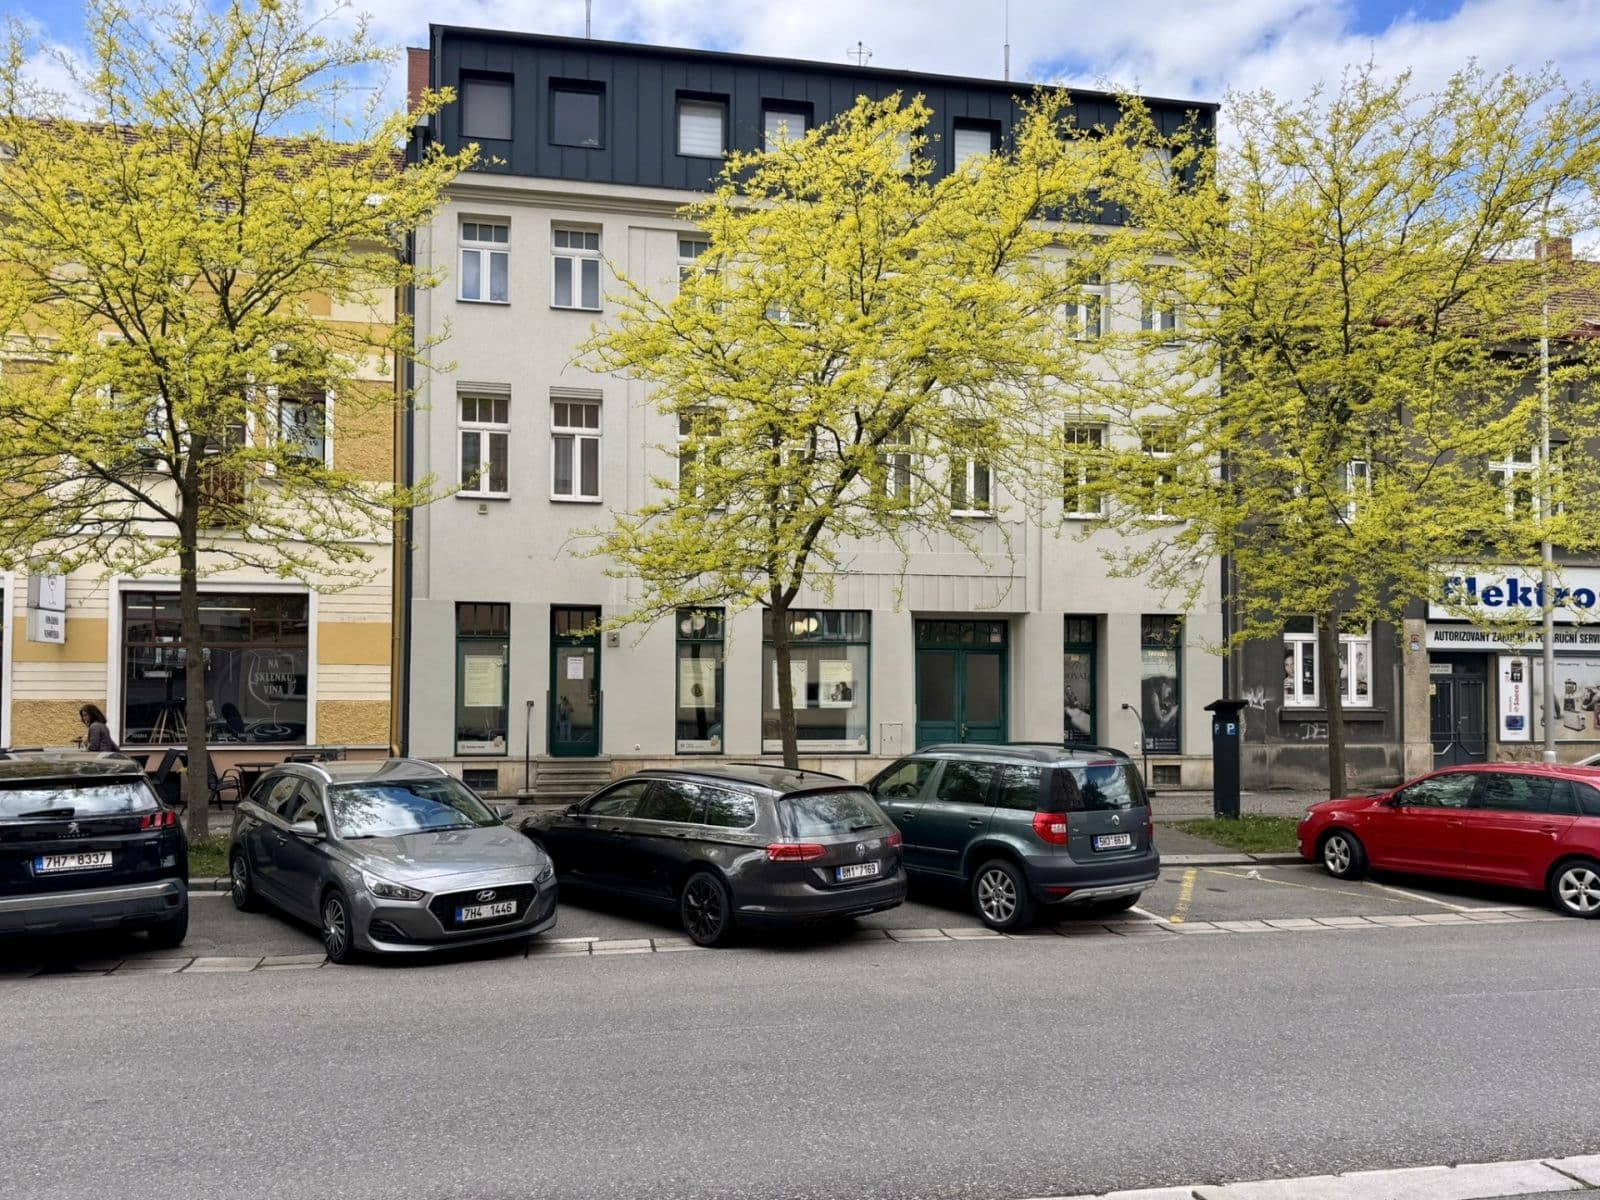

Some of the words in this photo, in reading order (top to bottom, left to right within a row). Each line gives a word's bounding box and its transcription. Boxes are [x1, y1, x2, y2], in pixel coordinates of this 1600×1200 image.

[46, 855, 68, 867] 7H7
[77, 853, 107, 865] 8337
[464, 907, 482, 919] 7H4
[490, 902, 513, 915] 1446
